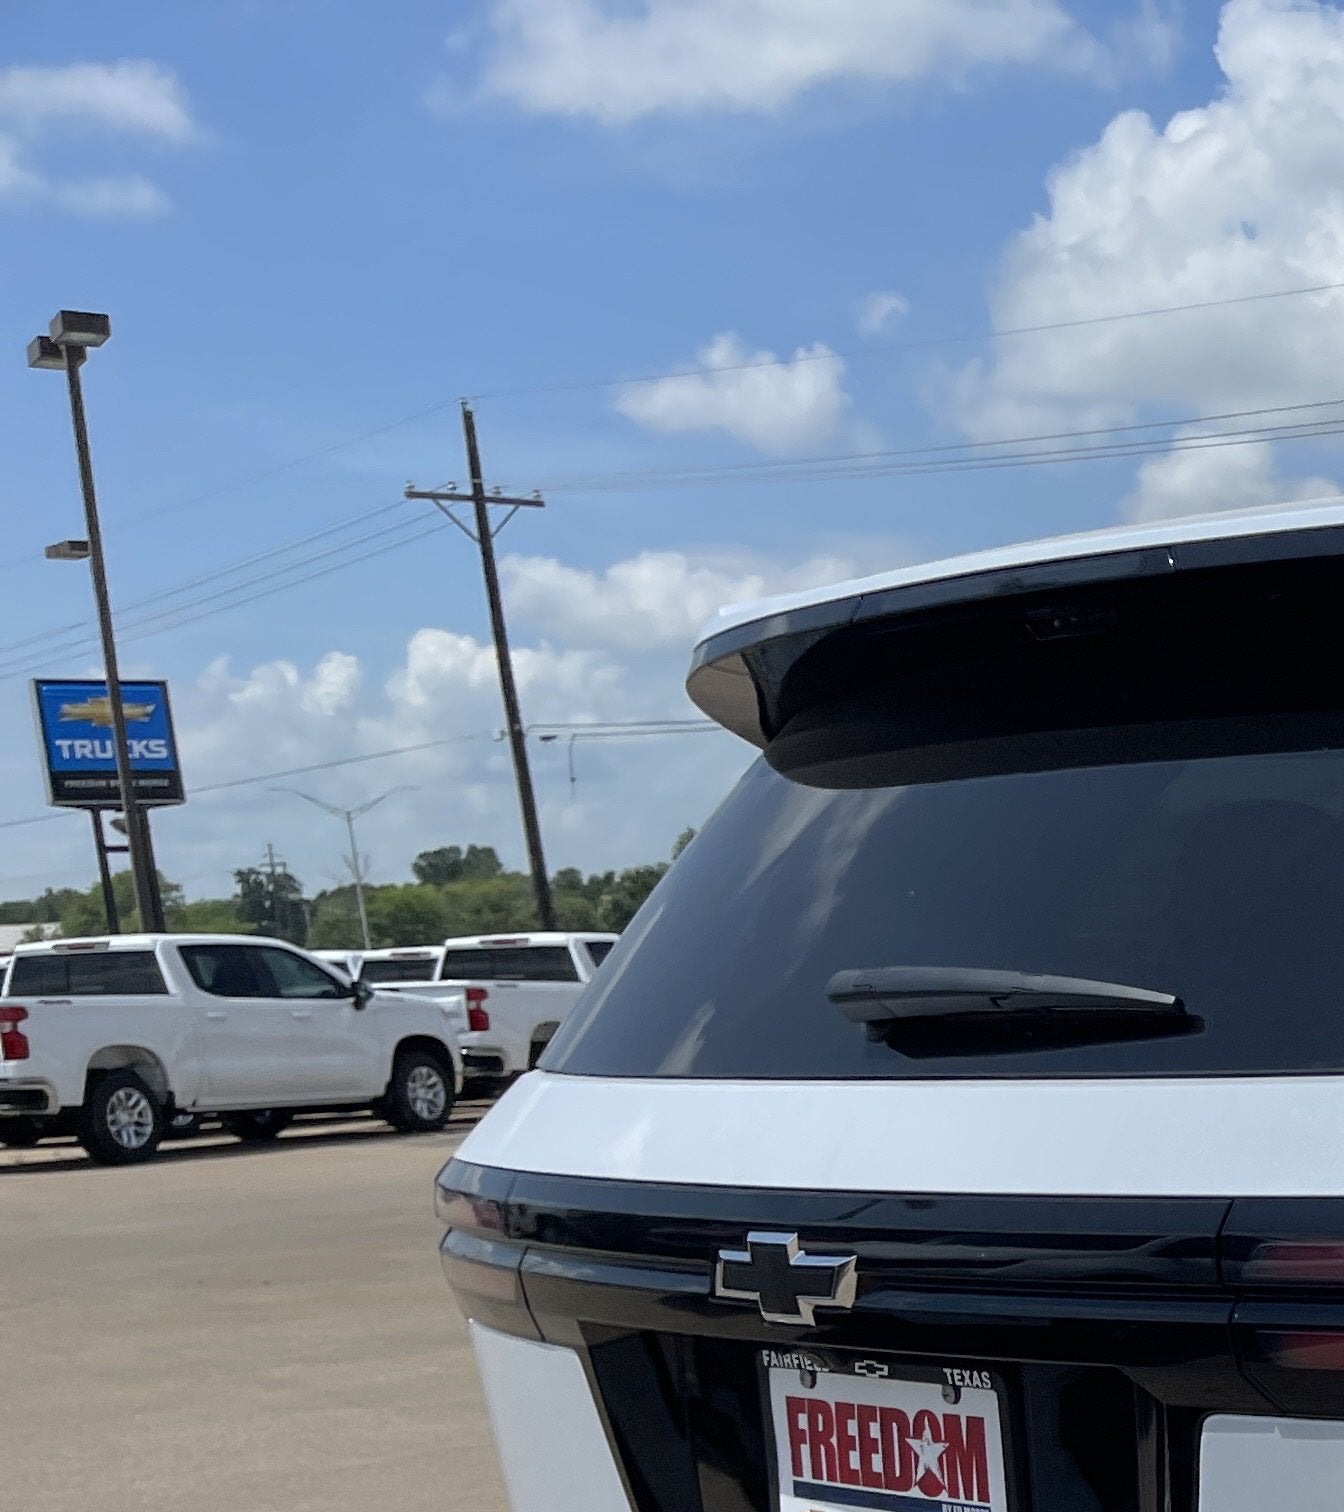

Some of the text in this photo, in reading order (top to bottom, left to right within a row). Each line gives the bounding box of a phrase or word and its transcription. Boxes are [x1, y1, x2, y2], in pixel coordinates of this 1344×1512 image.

[55, 739, 168, 760] TRUKS
[943, 1368, 991, 1389] TEXAS
[785, 1396, 991, 1504] FREEDOM
